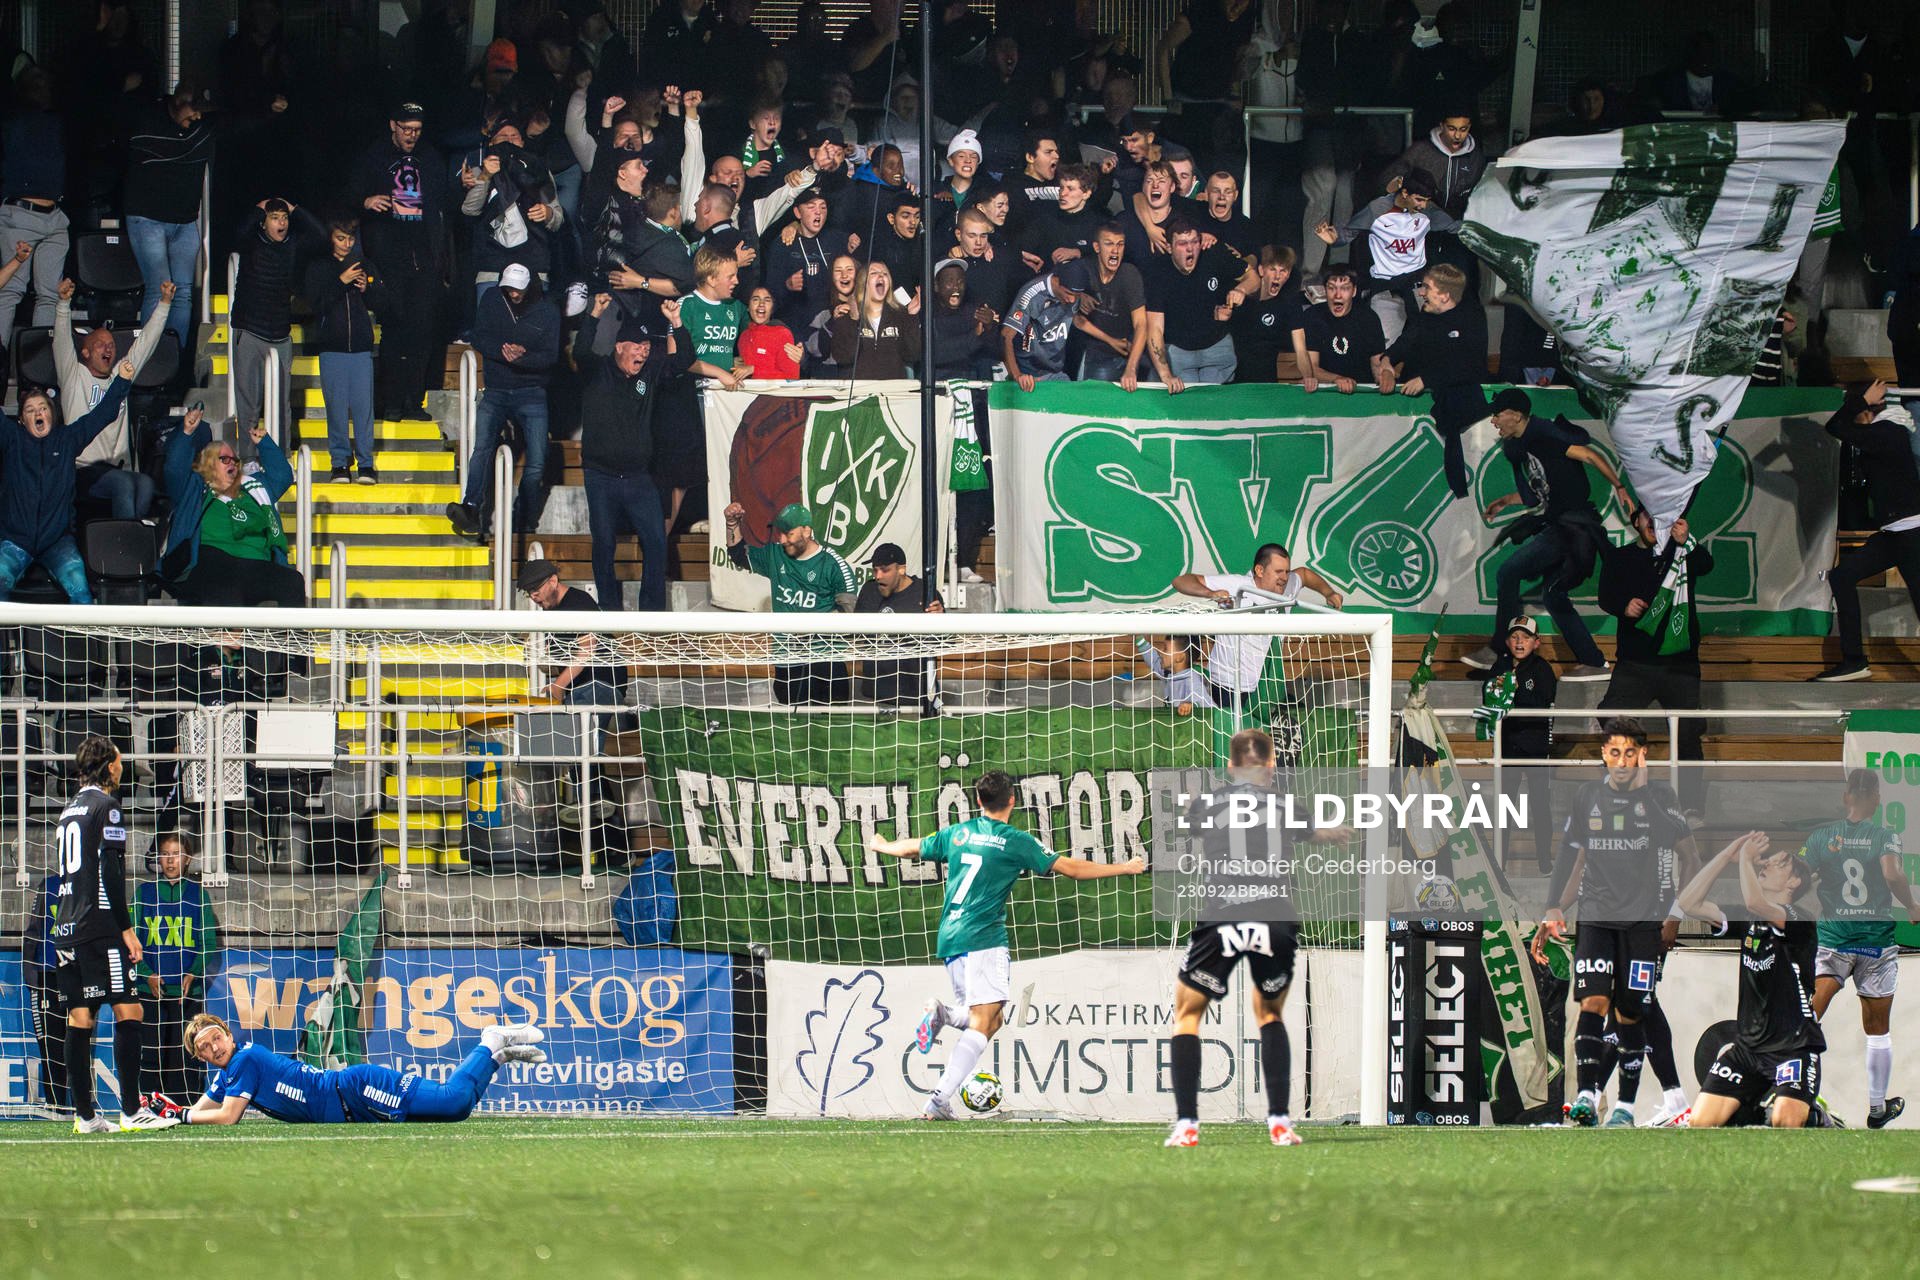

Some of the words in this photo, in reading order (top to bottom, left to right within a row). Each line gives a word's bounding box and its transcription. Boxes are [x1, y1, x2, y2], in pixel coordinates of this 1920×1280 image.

[1385, 238, 1416, 254] AXA
[703, 325, 737, 340] SSAB
[1588, 838, 1634, 850] BEHRN
[951, 852, 983, 905] 7
[1841, 858, 1868, 906] 8
[144, 916, 196, 947] XXL
[1217, 922, 1274, 957] NA
[1441, 921, 1475, 932] OBOS
[1002, 1004, 1222, 1026] VOKATFIRMN
[1391, 941, 1405, 1103] SELECT
[1425, 940, 1465, 1103] SELECT
[509, 1055, 686, 1091] trevligaste
[902, 1038, 1263, 1095] GIMSTEDT
[1435, 1115, 1470, 1126] OBOS
